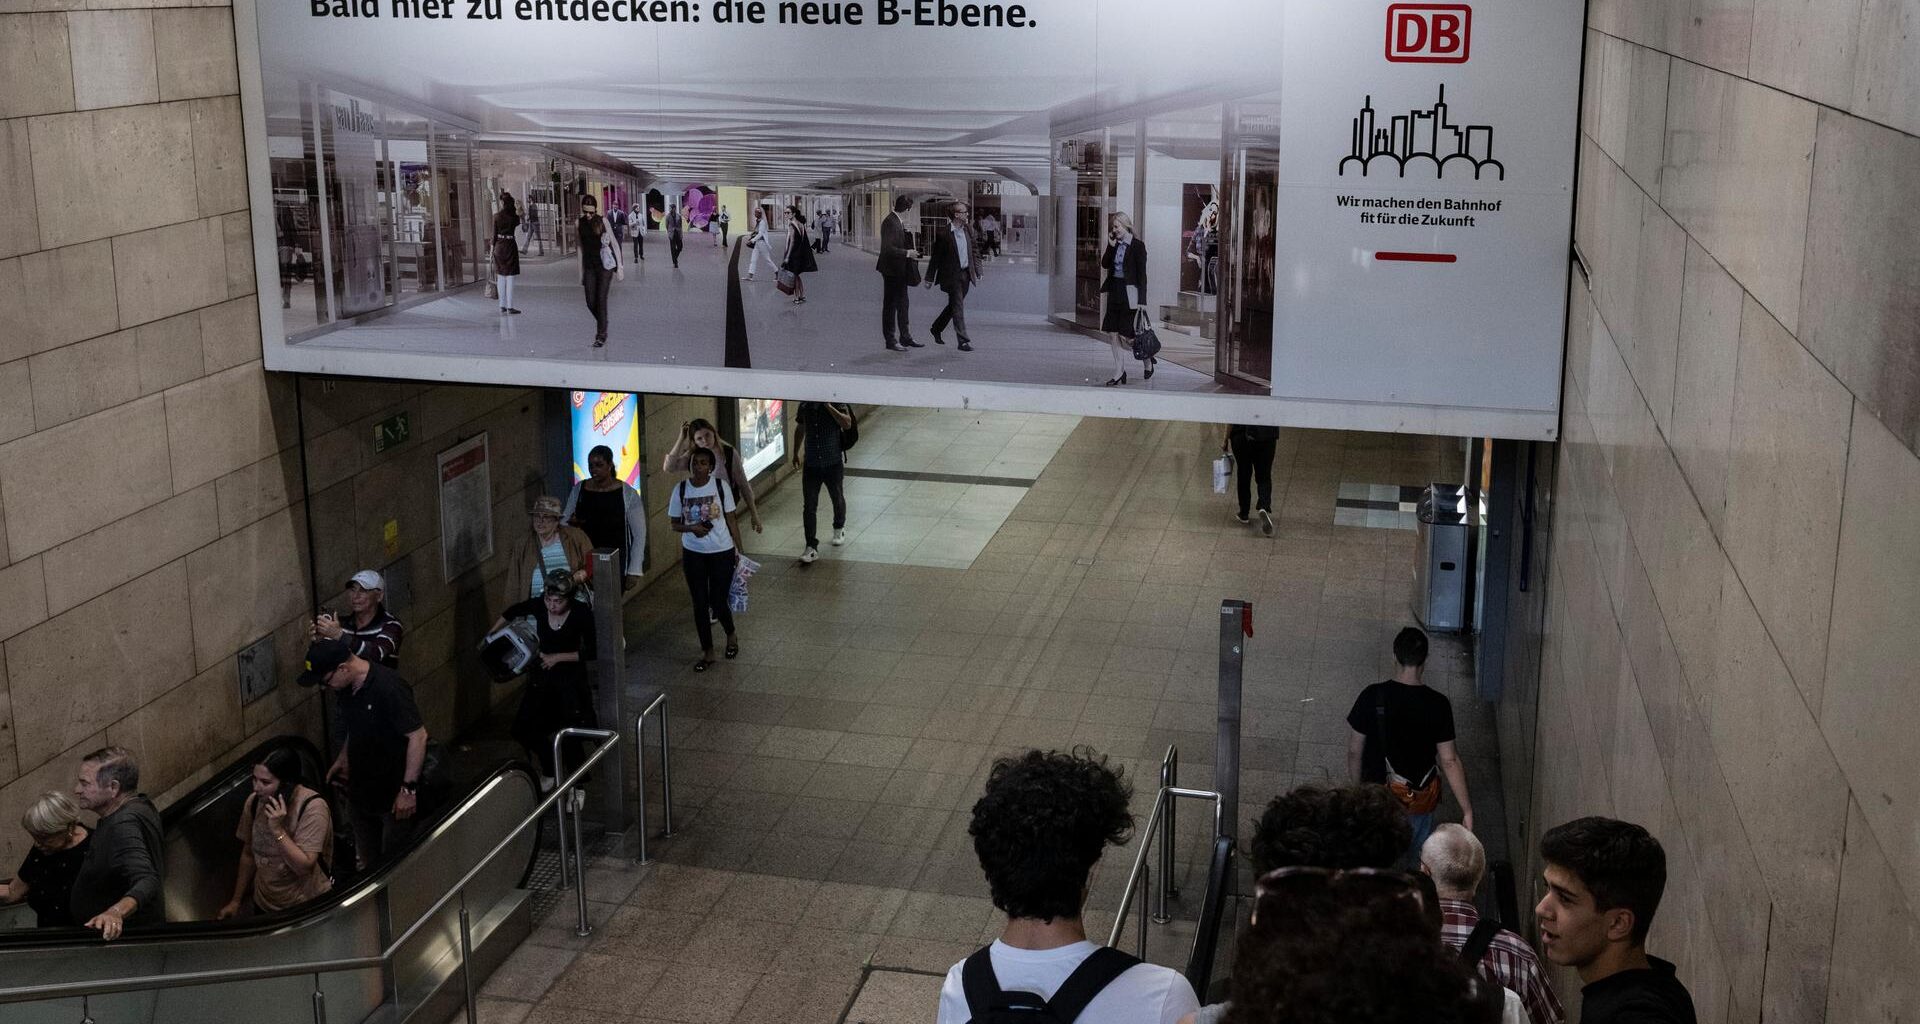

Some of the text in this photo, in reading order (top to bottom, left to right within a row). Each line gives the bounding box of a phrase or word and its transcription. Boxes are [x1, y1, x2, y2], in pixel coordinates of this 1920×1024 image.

[310, 0, 1037, 28] Bald hier zu entdecken: die neue B-Ebene.
[1396, 14, 1461, 54] DB
[1337, 195, 1502, 212] Wir machen den Bahnhof
[1360, 212, 1475, 228] fit für die Zukunft
